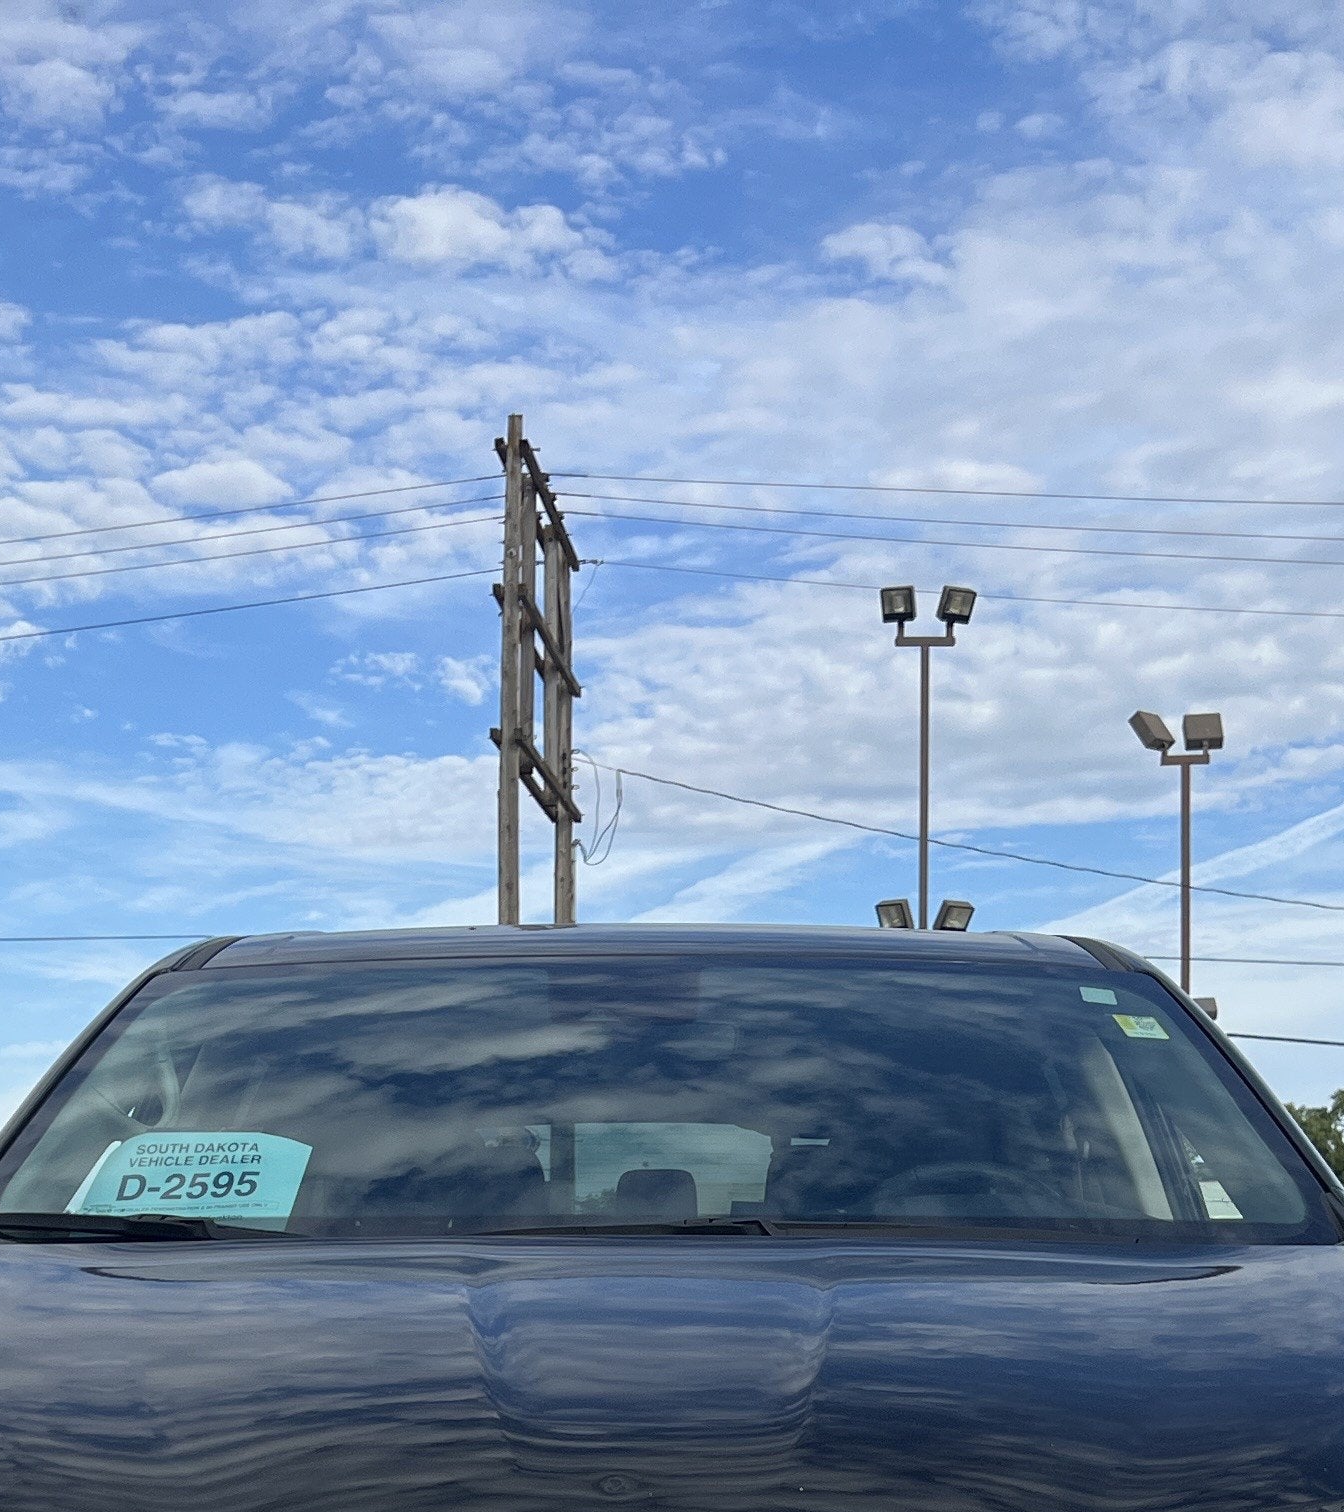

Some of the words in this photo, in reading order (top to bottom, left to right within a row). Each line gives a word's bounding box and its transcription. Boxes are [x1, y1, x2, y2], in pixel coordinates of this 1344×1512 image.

[136, 1143, 189, 1155] SOUTH
[195, 1142, 259, 1153] DAKOTA
[129, 1156, 194, 1167] VEHICLE
[199, 1154, 261, 1165] DEALER
[116, 1172, 260, 1201] D-2595
